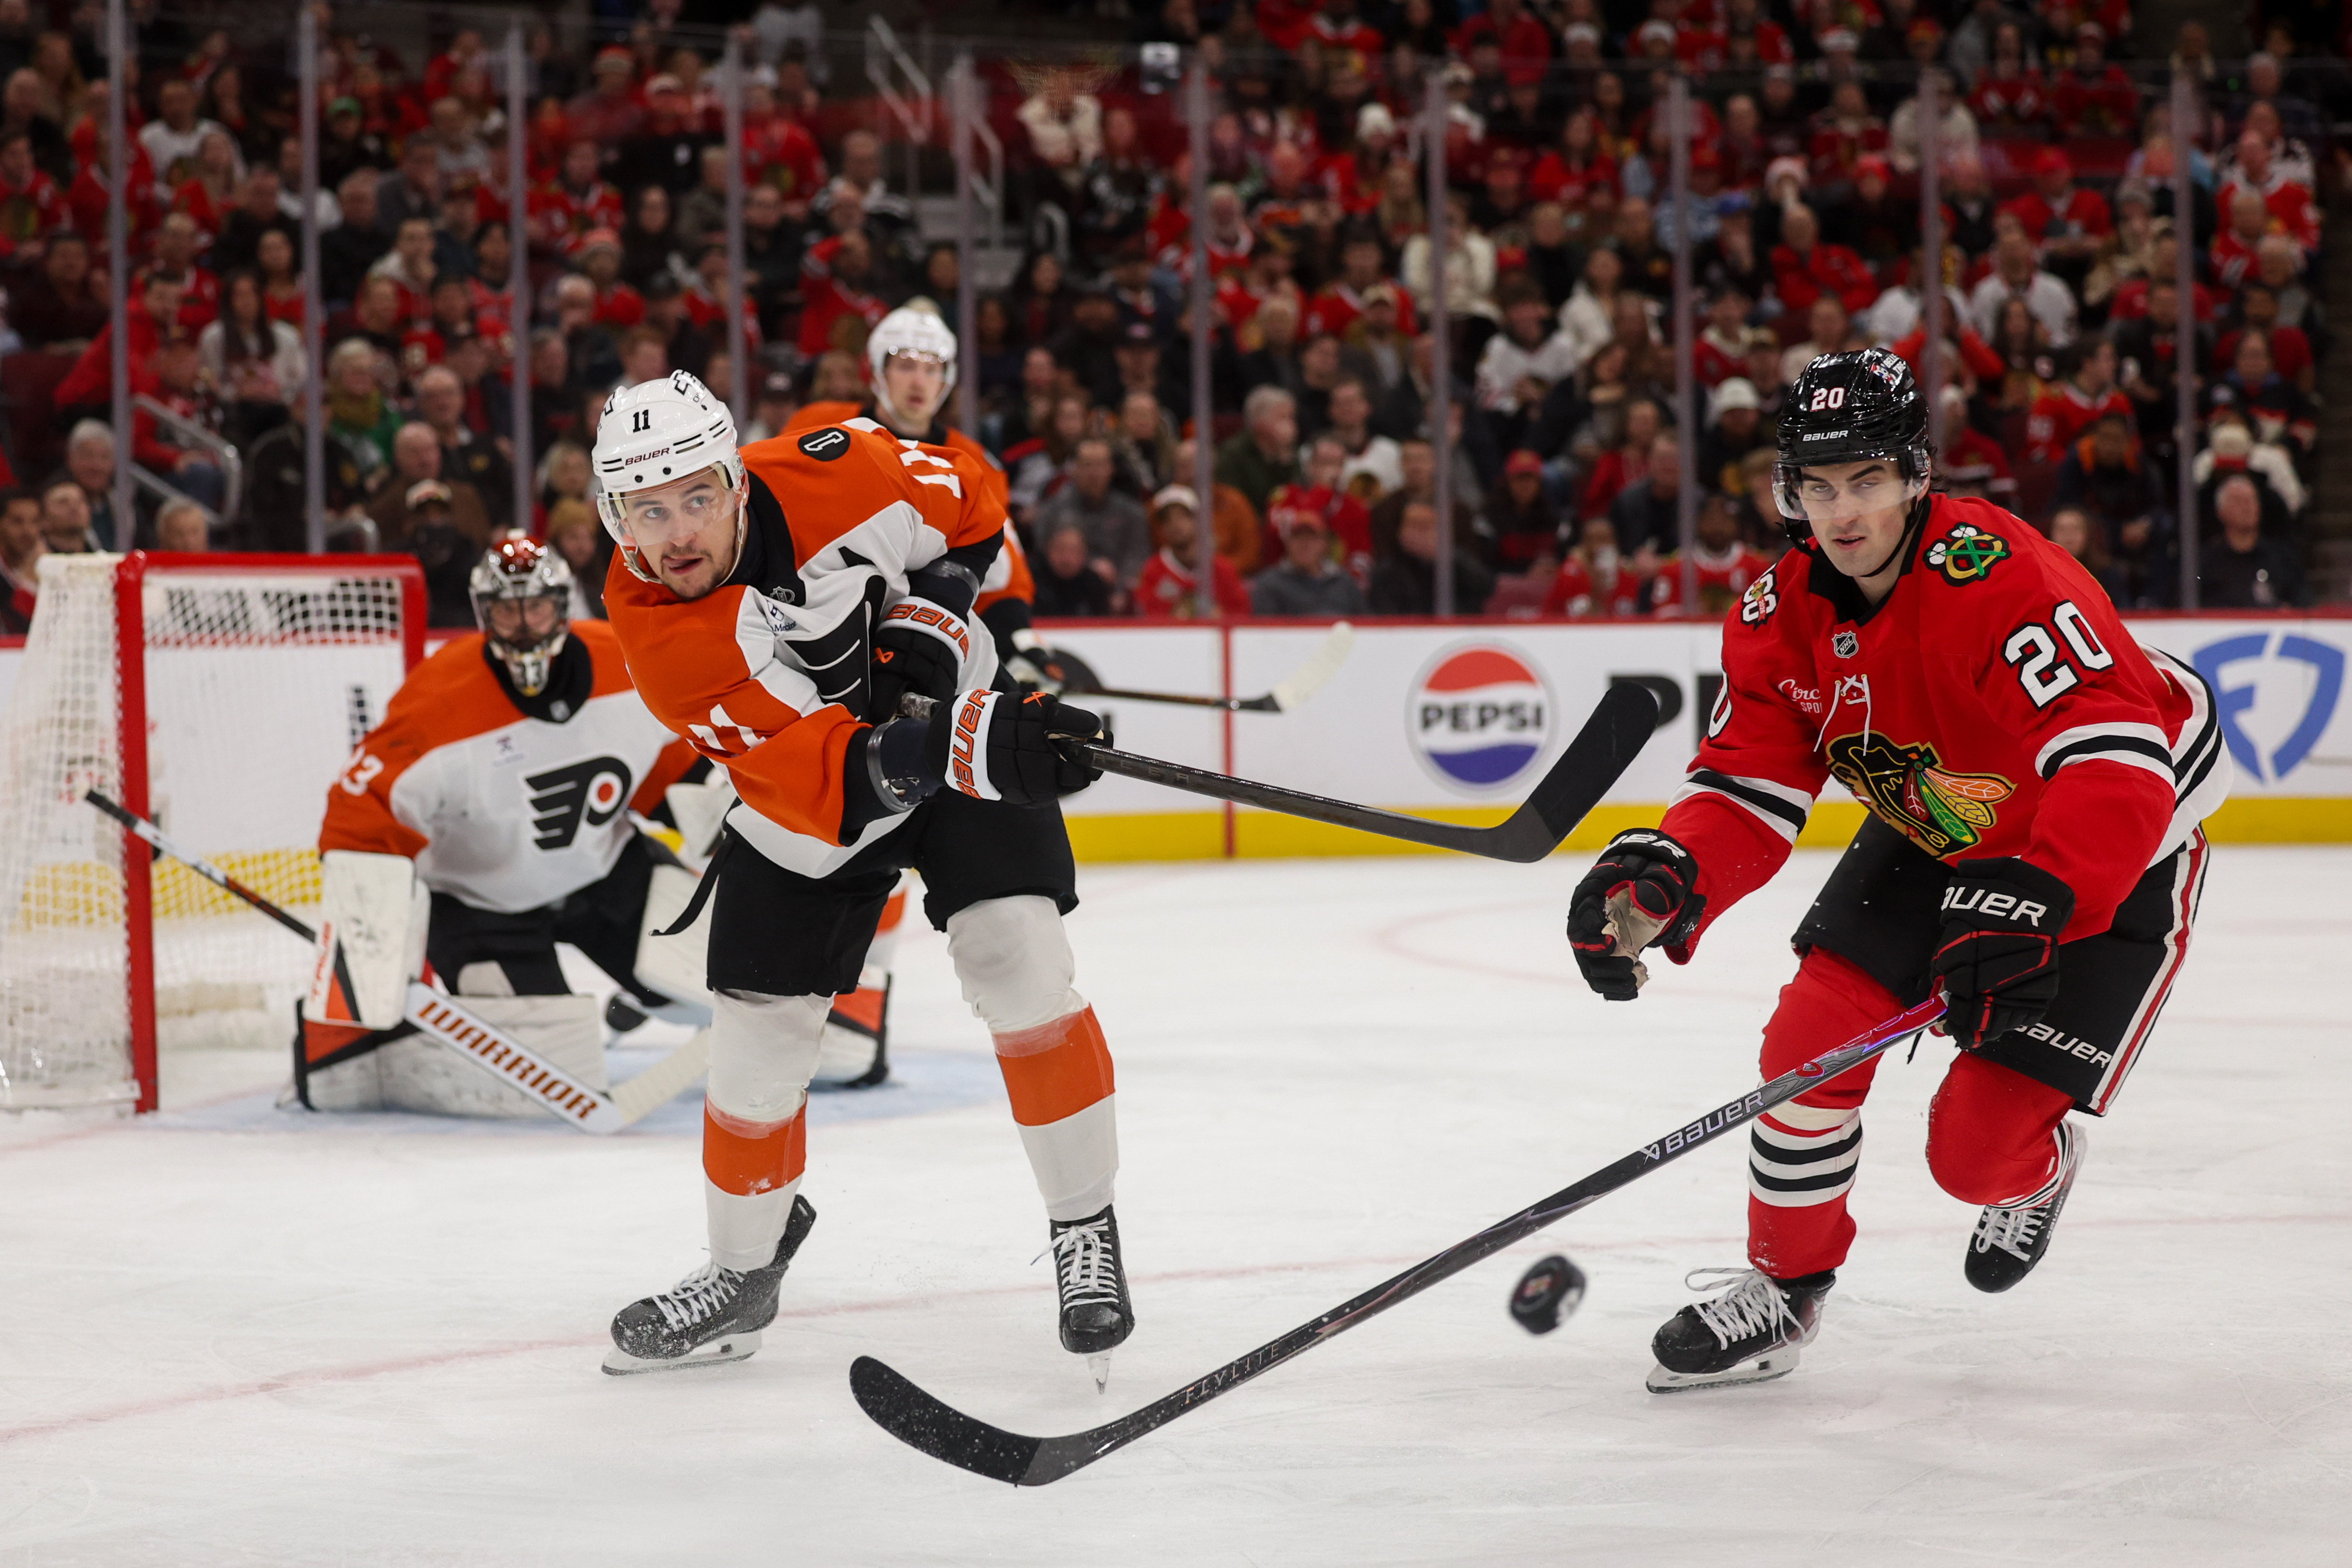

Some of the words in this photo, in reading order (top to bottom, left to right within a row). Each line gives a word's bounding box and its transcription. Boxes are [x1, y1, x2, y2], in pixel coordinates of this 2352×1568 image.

[1810, 387, 1845, 411] 20
[633, 409, 650, 433] 11
[1802, 430, 1849, 441] BAUER
[625, 448, 670, 466] BAUER
[885, 603, 970, 662] BAUE
[1839, 638, 1853, 654] NHL
[2005, 602, 2113, 709] 20
[1778, 679, 1821, 701] Circ
[1421, 701, 1542, 731] PEPSI
[952, 688, 994, 800] BAUER
[418, 1000, 599, 1121] WARRIOR
[2013, 1022, 2113, 1069] AUER
[1665, 1091, 1765, 1154] BAUER
[1184, 1344, 1279, 1404] FLYLITE
